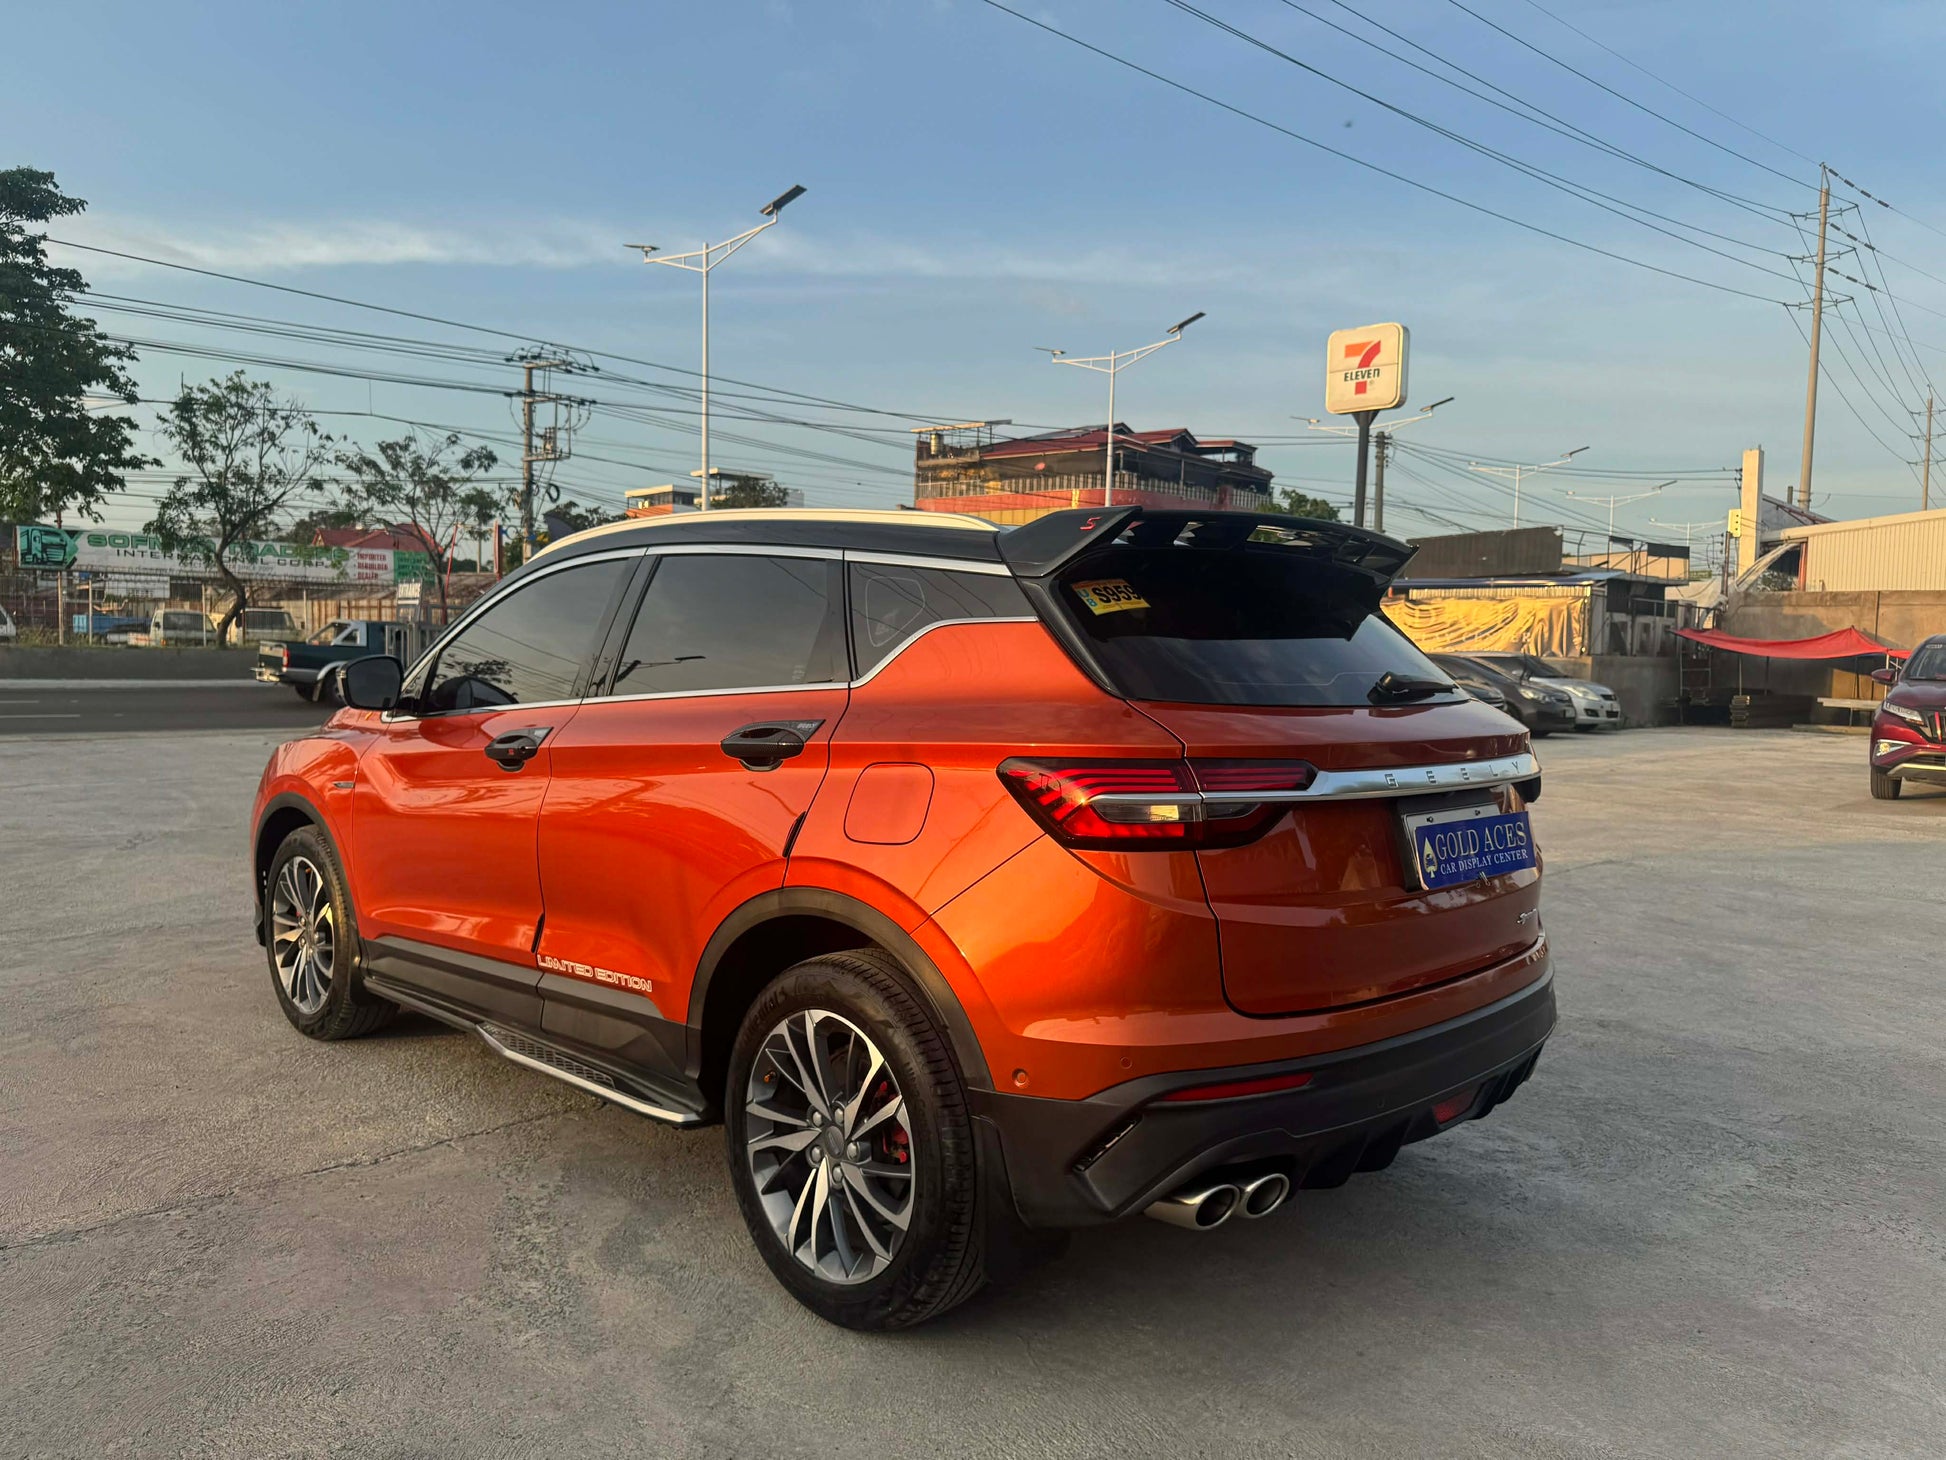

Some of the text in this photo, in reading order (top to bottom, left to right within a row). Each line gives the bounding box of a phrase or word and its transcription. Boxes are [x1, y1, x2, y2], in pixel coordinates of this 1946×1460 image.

[117, 549, 269, 565] INTERNAONL
[1385, 761, 1520, 788] GEELY
[1434, 821, 1527, 861] GOLD ACES
[1440, 848, 1529, 875] CAR DISPLAY CENTER
[536, 954, 653, 993] LIMITED EDITION
